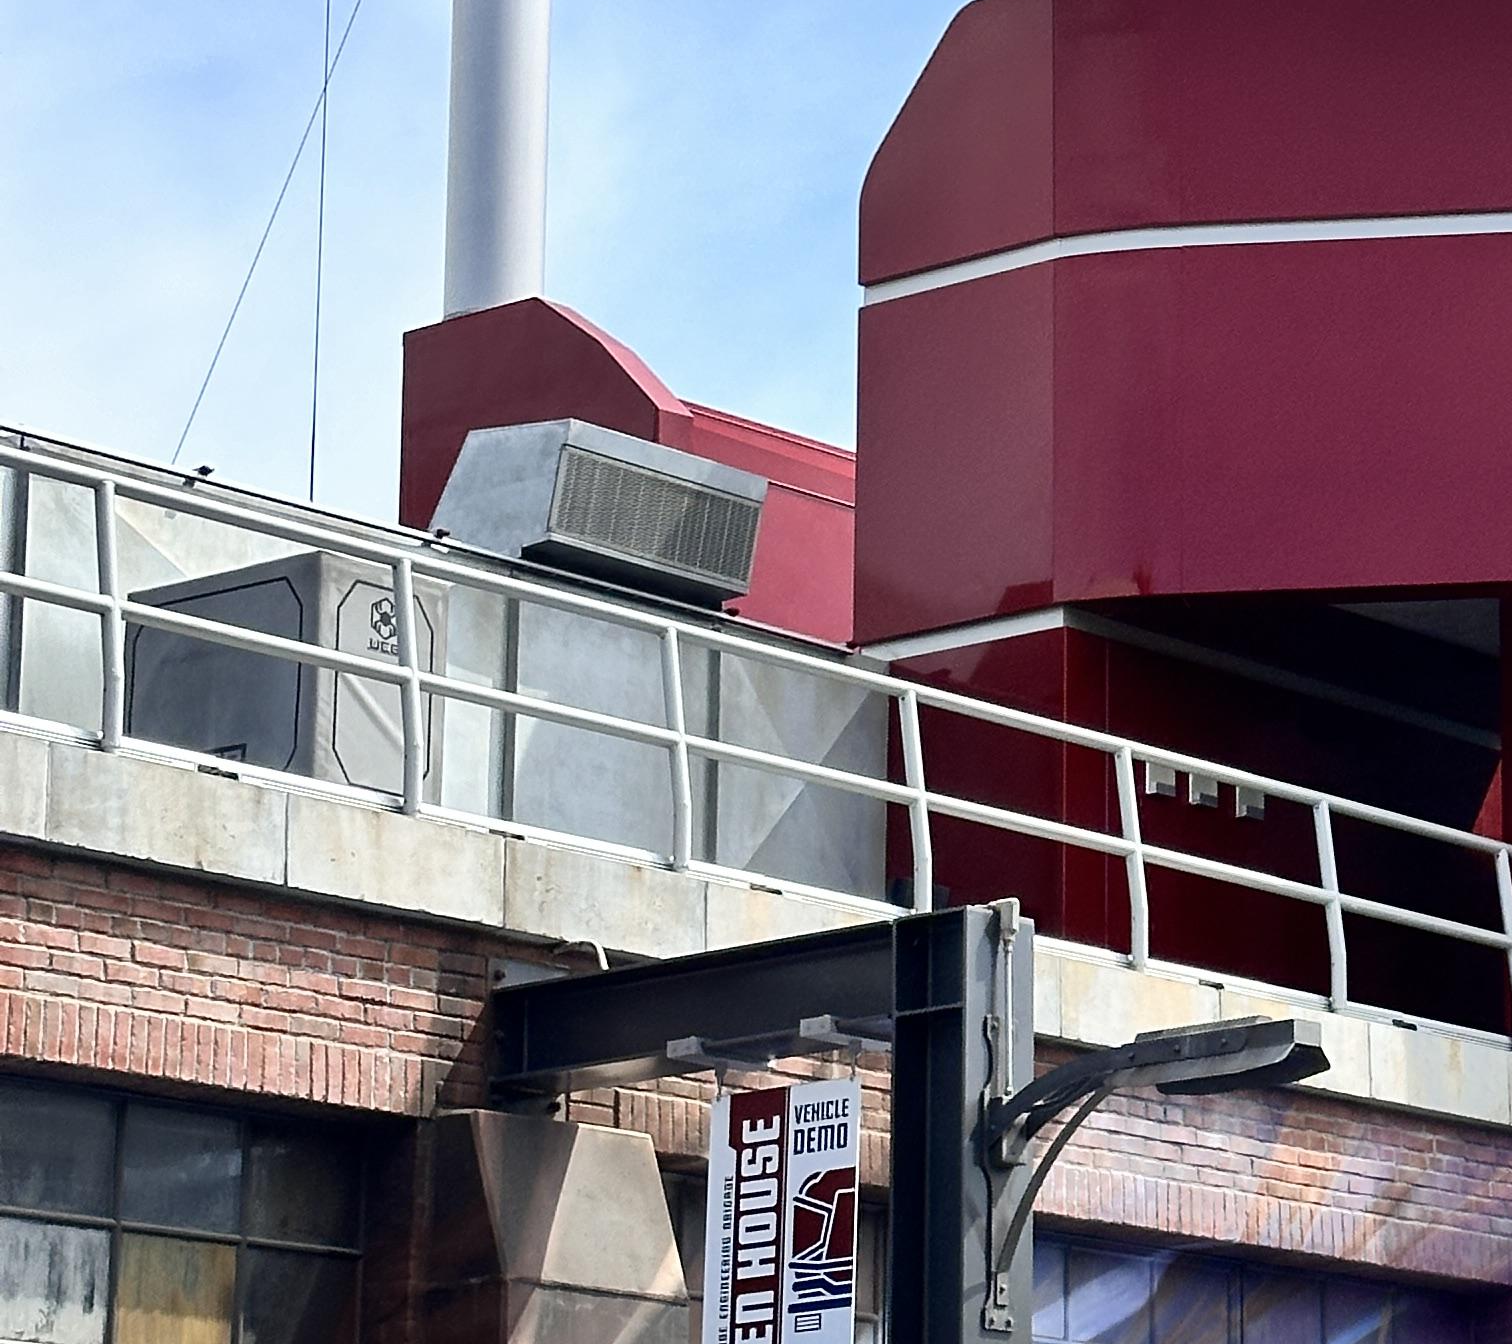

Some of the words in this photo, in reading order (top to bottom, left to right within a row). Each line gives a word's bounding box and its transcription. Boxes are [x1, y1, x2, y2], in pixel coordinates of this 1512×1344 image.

[795, 1098, 849, 1124] VEHICLE
[793, 1123, 848, 1155] DEMO
[737, 1115, 781, 1280] HOUSE
